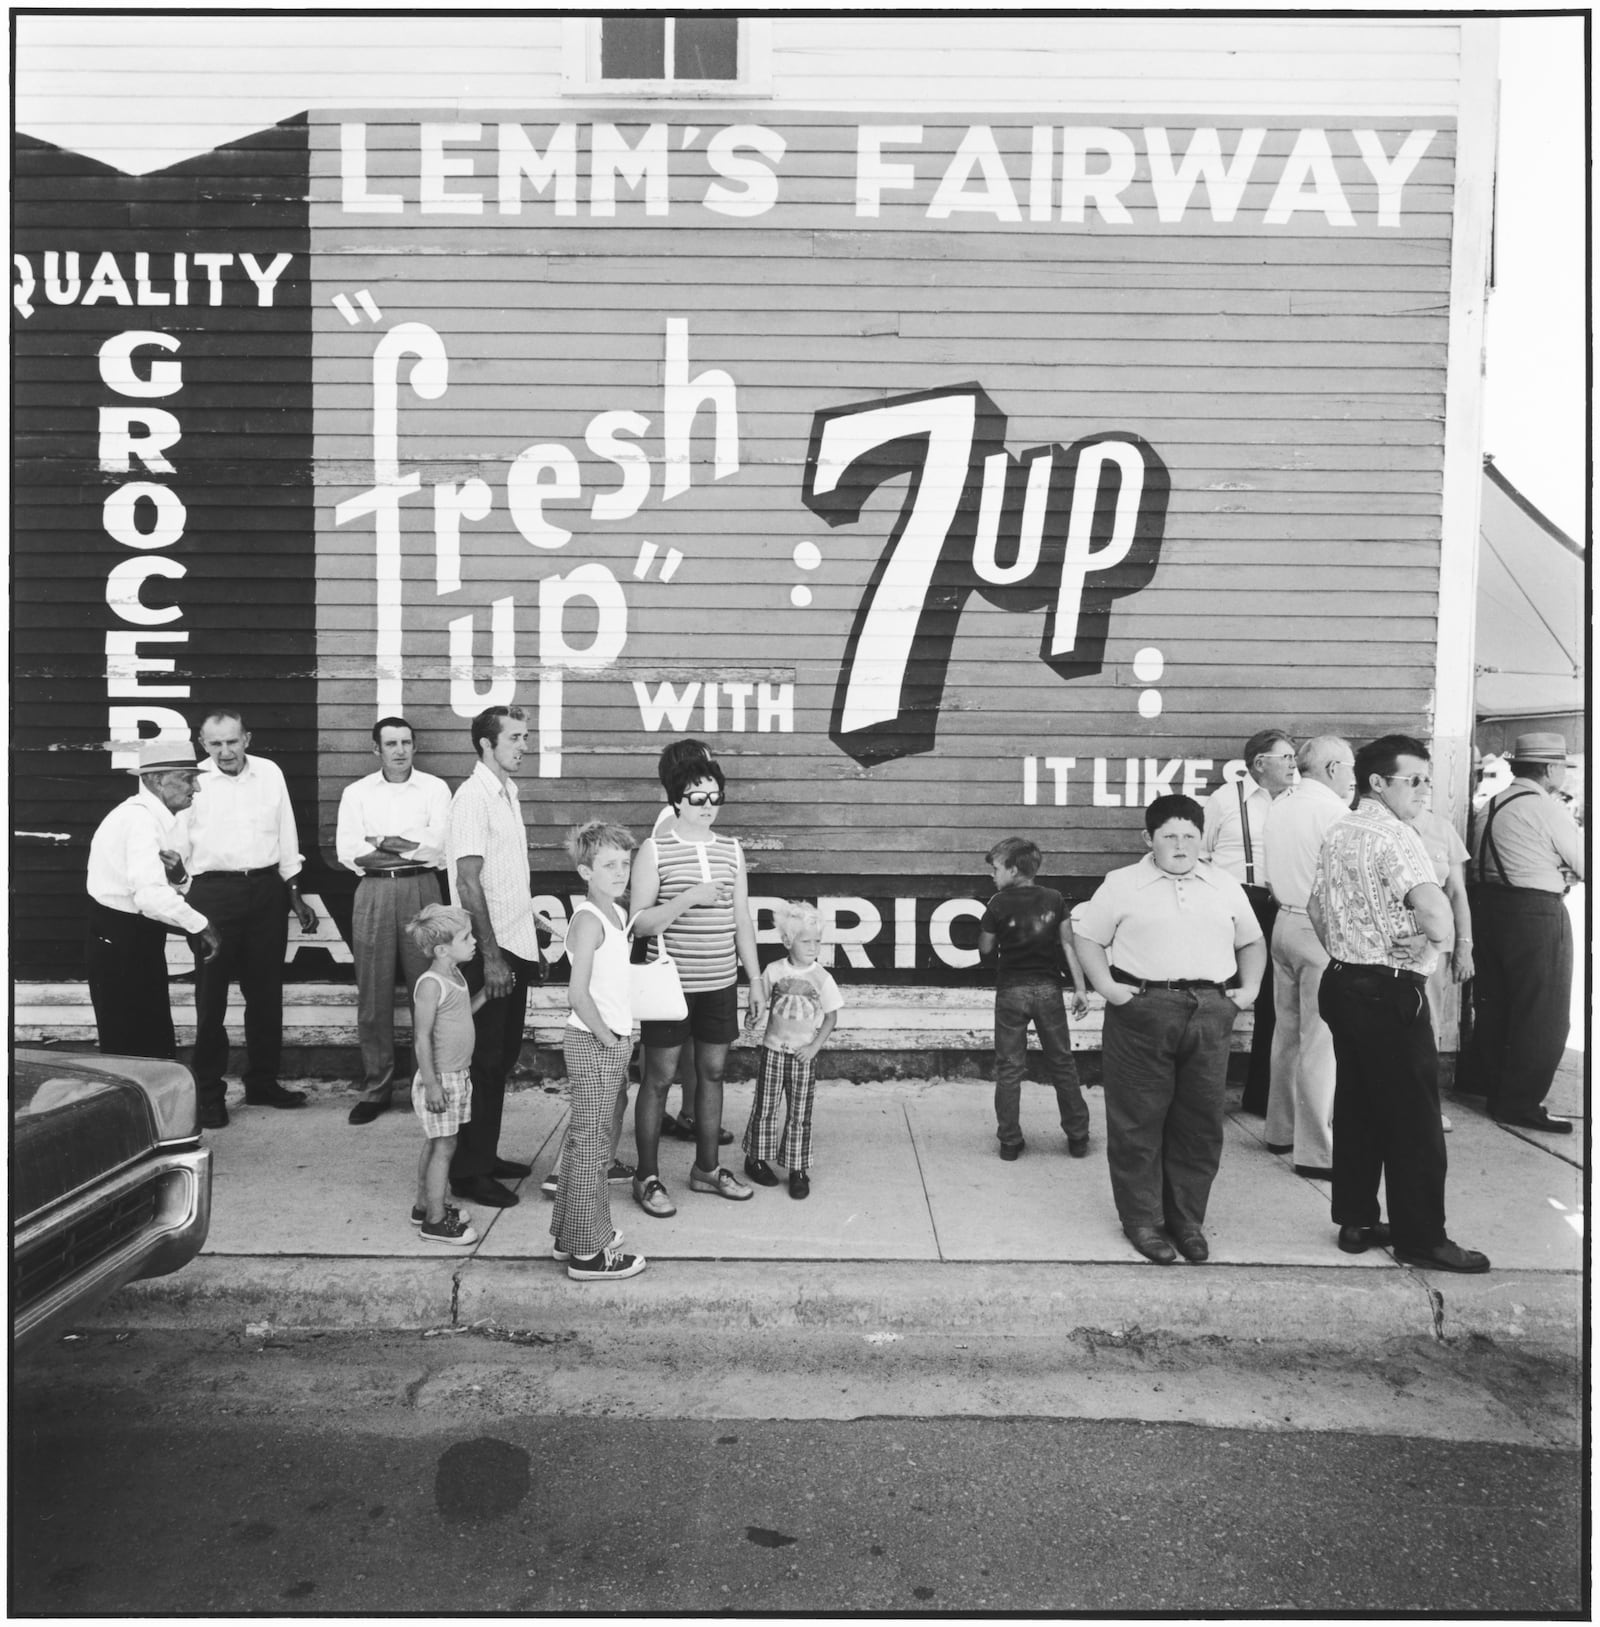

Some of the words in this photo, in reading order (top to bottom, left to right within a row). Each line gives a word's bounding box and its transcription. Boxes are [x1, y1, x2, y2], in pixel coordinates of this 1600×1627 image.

[339, 121, 788, 218] LEMM'S
[854, 124, 1438, 228] FAIRWAY
[632, 681, 795, 733] WITH
[1023, 757, 1076, 806] IT
